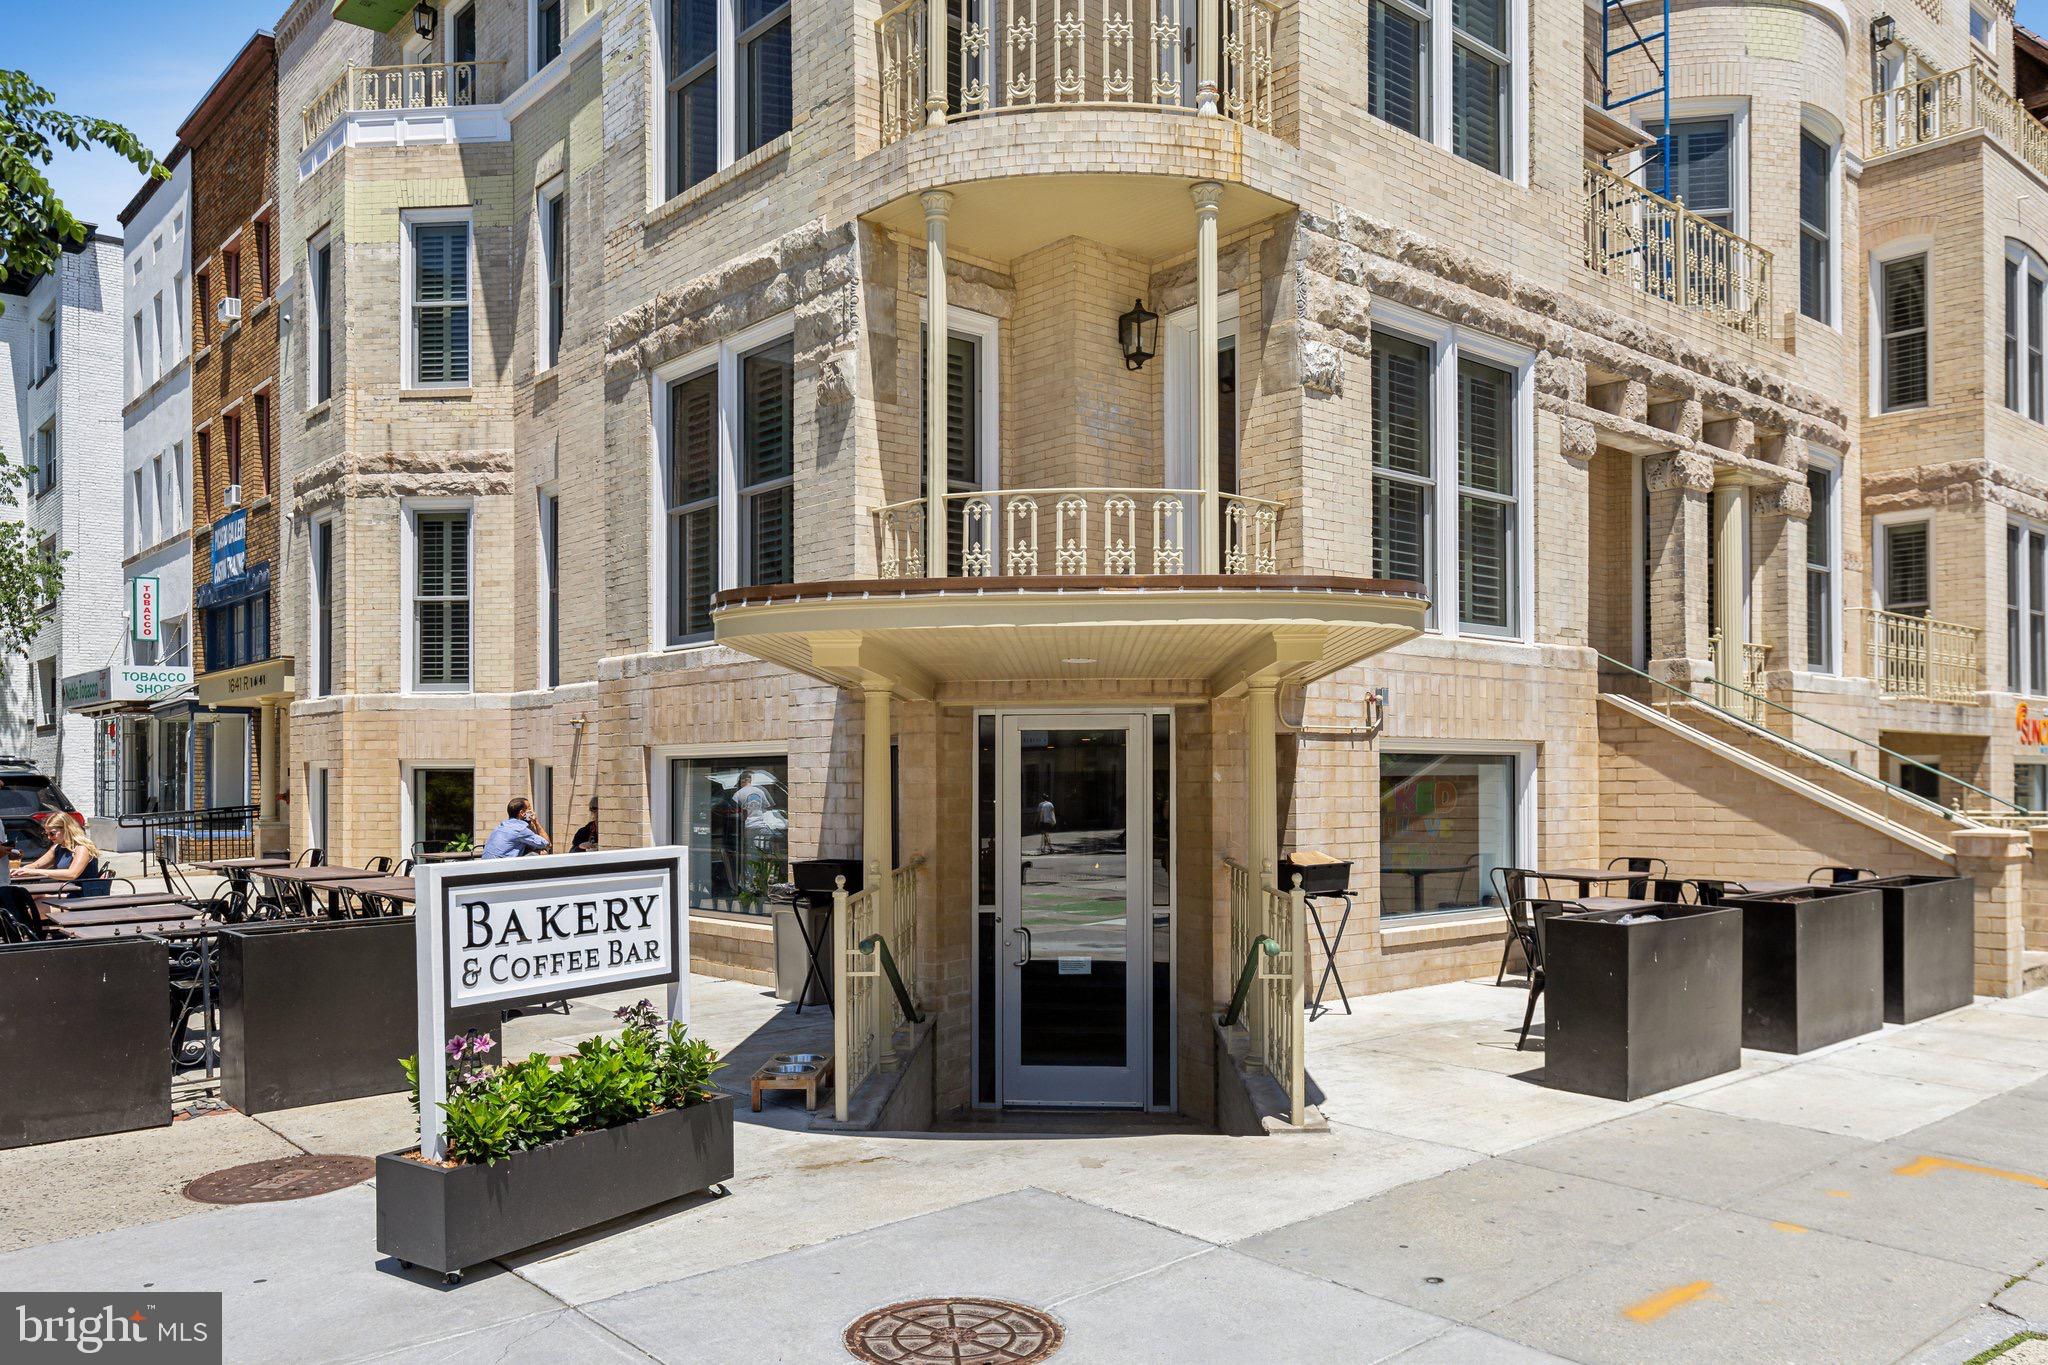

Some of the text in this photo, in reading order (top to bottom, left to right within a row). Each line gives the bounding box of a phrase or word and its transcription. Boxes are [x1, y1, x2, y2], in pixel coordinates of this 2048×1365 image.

[143, 585, 151, 635] TOBACCO
[122, 671, 186, 683] TOBACCO
[228, 677, 242, 693] 1641
[244, 676, 249, 691] R
[462, 894, 660, 951] BAKERY
[462, 939, 661, 988] & COFFEE BAR
